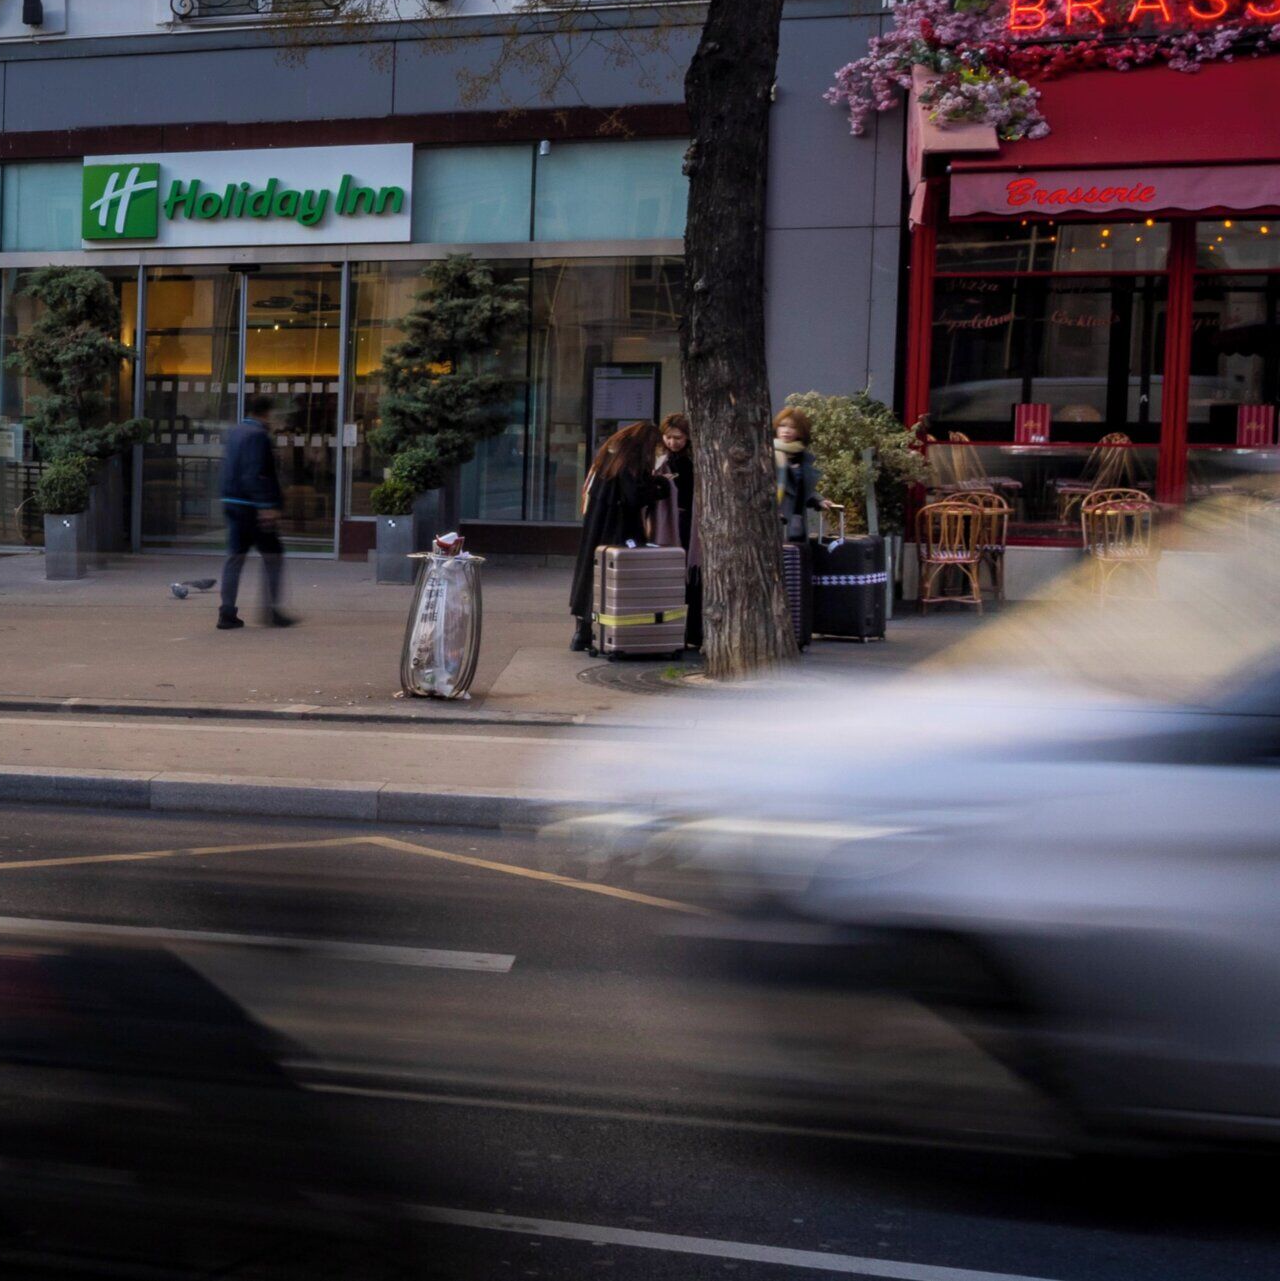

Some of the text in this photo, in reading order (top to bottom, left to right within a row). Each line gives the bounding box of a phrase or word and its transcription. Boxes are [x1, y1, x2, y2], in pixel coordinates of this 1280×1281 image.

[163, 174, 404, 227] Holiday Inn
[1006, 177, 1156, 207] Brasserie
